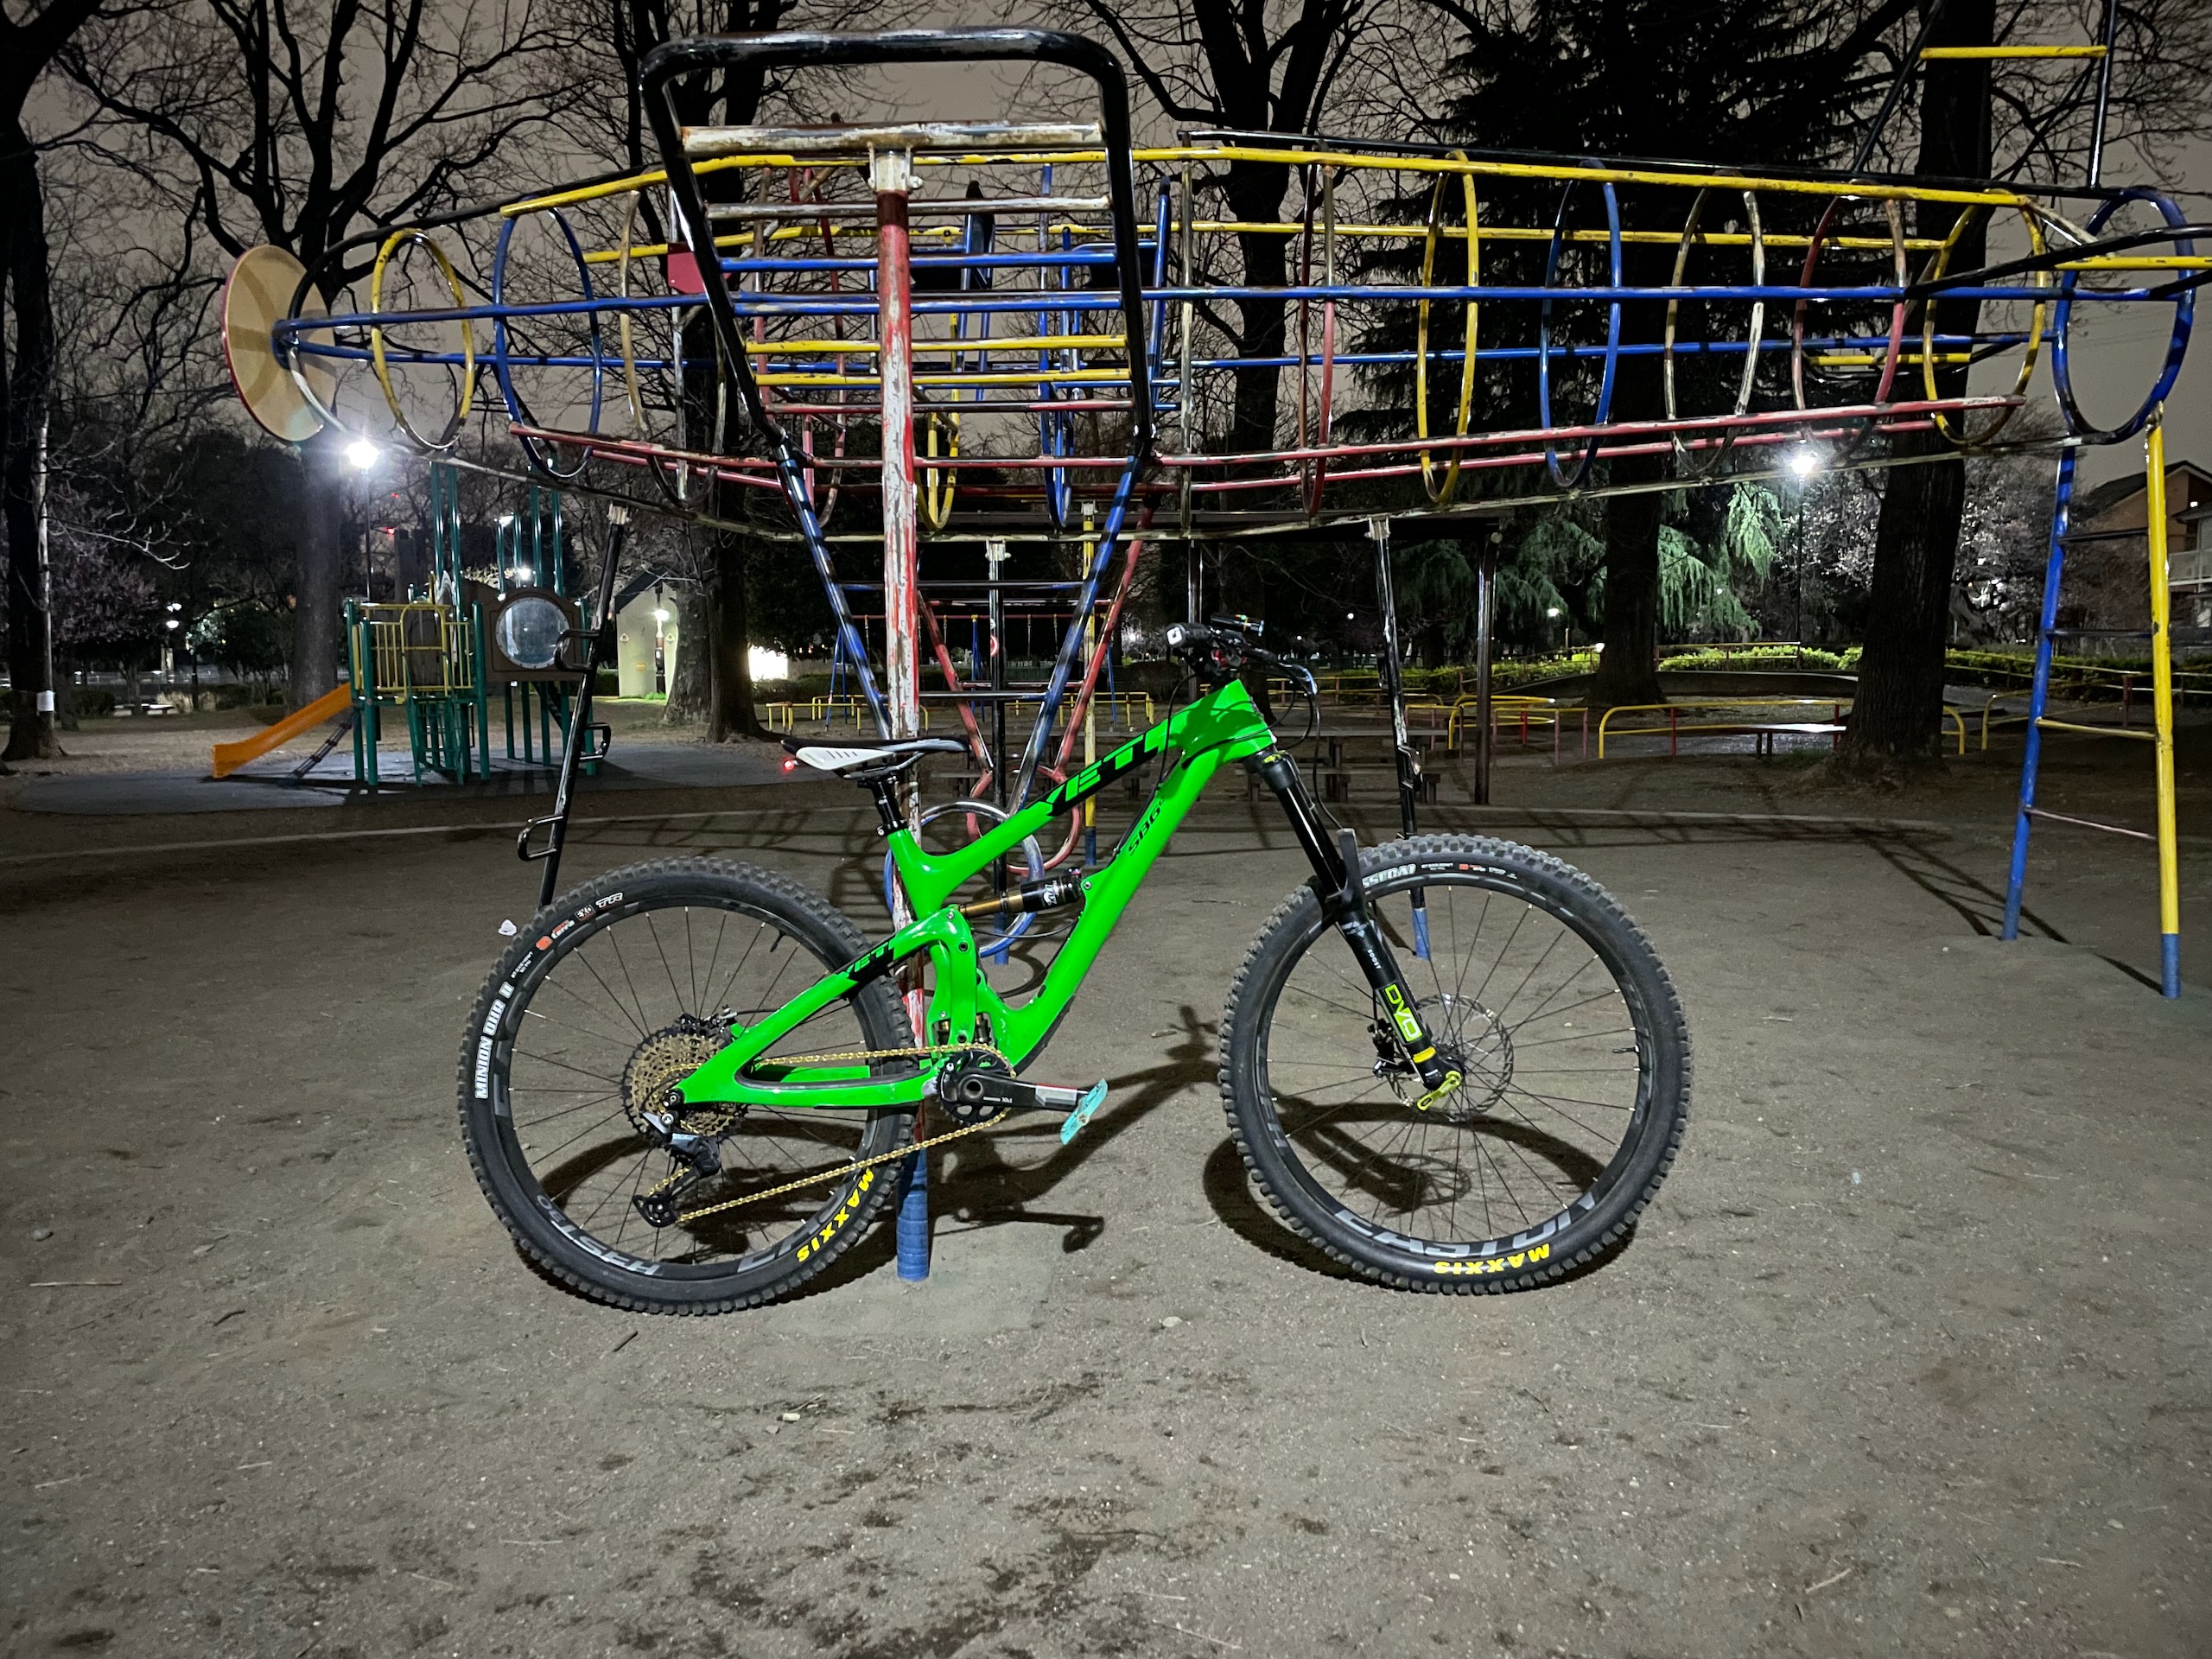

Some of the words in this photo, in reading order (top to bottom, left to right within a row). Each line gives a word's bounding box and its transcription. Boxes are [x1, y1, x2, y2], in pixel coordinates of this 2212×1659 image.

[1039, 734, 1160, 816] YETI
[1362, 864, 1416, 888] SSEGAI
[843, 940, 895, 980] YETI
[482, 998, 506, 1036] DHR
[1384, 983, 1421, 1039] DVO
[475, 1035, 493, 1100] MINION
[797, 1168, 874, 1262] MAXXIS
[1433, 1243, 1550, 1274] MAXXIS
